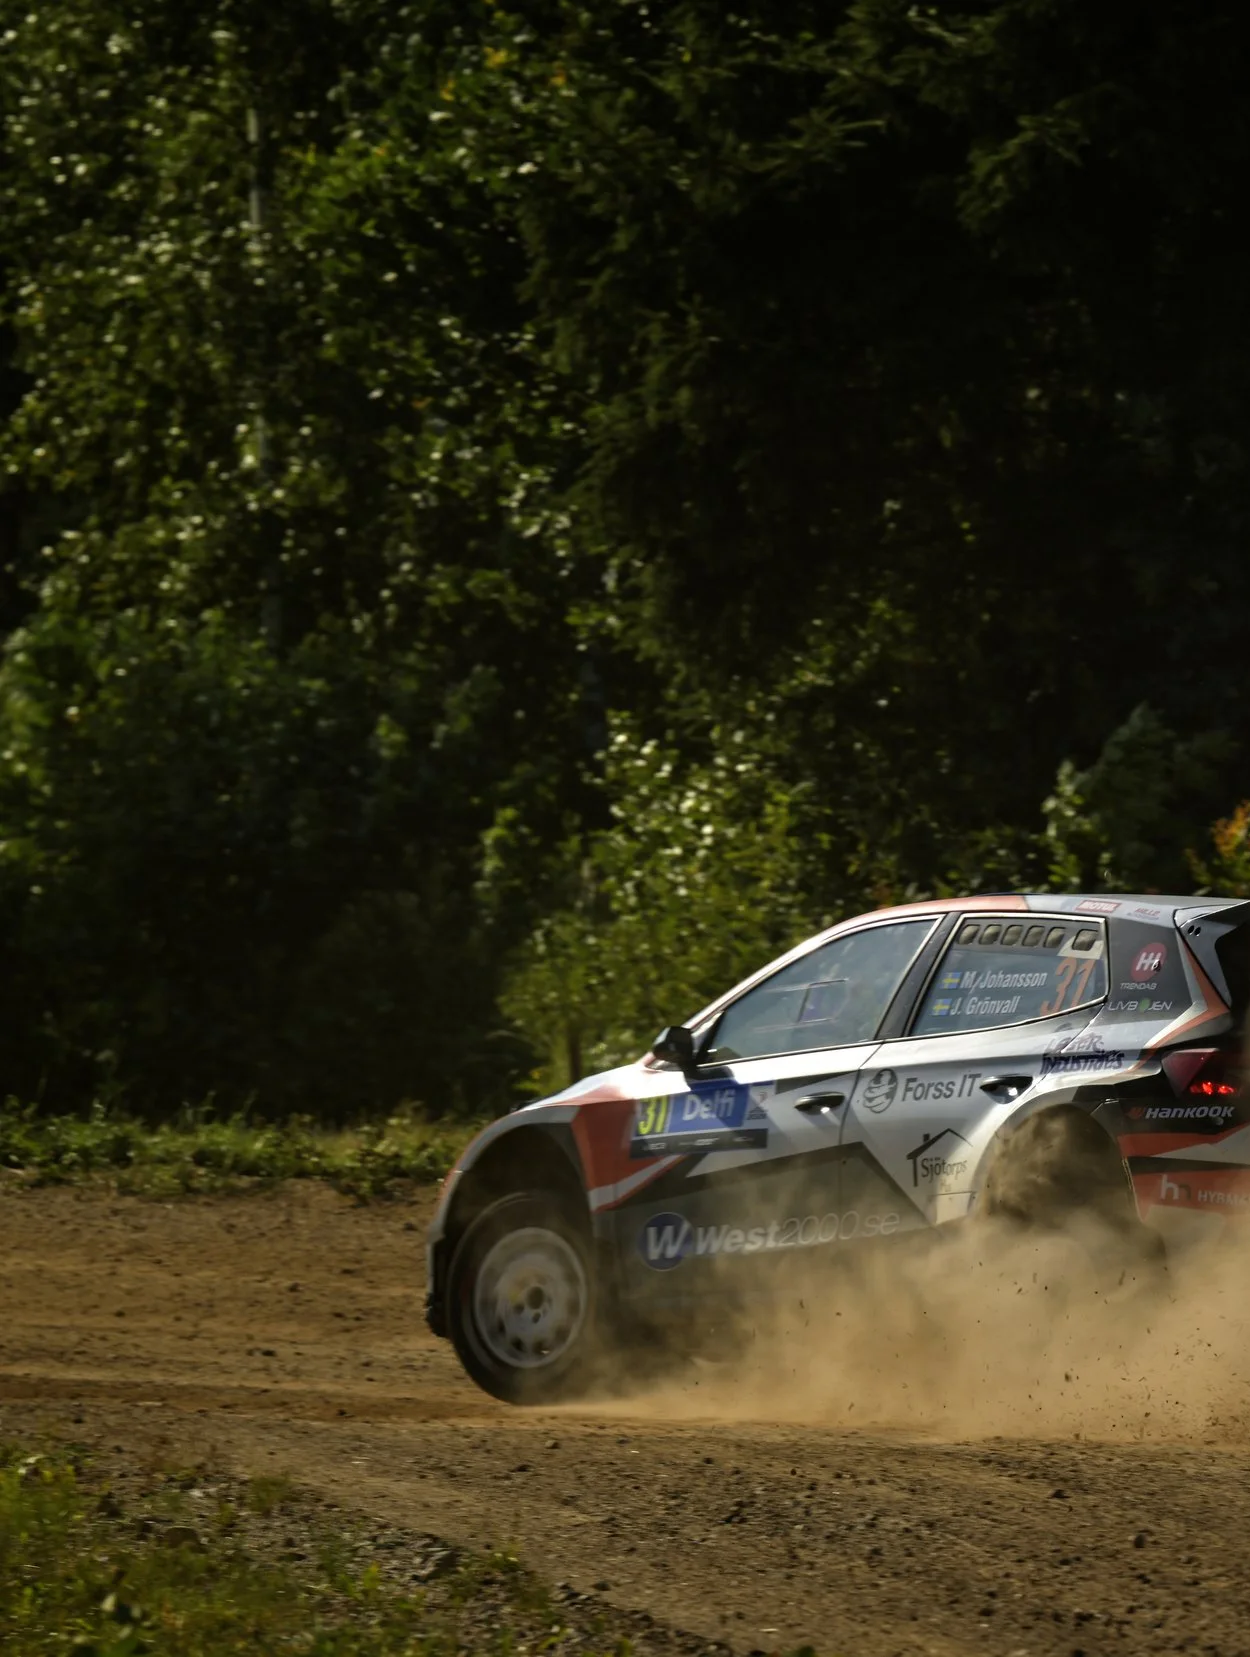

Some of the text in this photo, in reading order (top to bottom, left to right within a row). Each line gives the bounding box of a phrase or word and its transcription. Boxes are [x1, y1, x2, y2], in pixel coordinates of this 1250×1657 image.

[980, 970, 1048, 989] Johansson
[1040, 955, 1096, 1016] 31
[950, 996, 1021, 1016] J. Grönvall
[902, 1073, 982, 1102] Forss IT
[637, 1097, 669, 1135] 31
[682, 1089, 737, 1121] Delfi
[921, 1157, 968, 1184] Sjötorps
